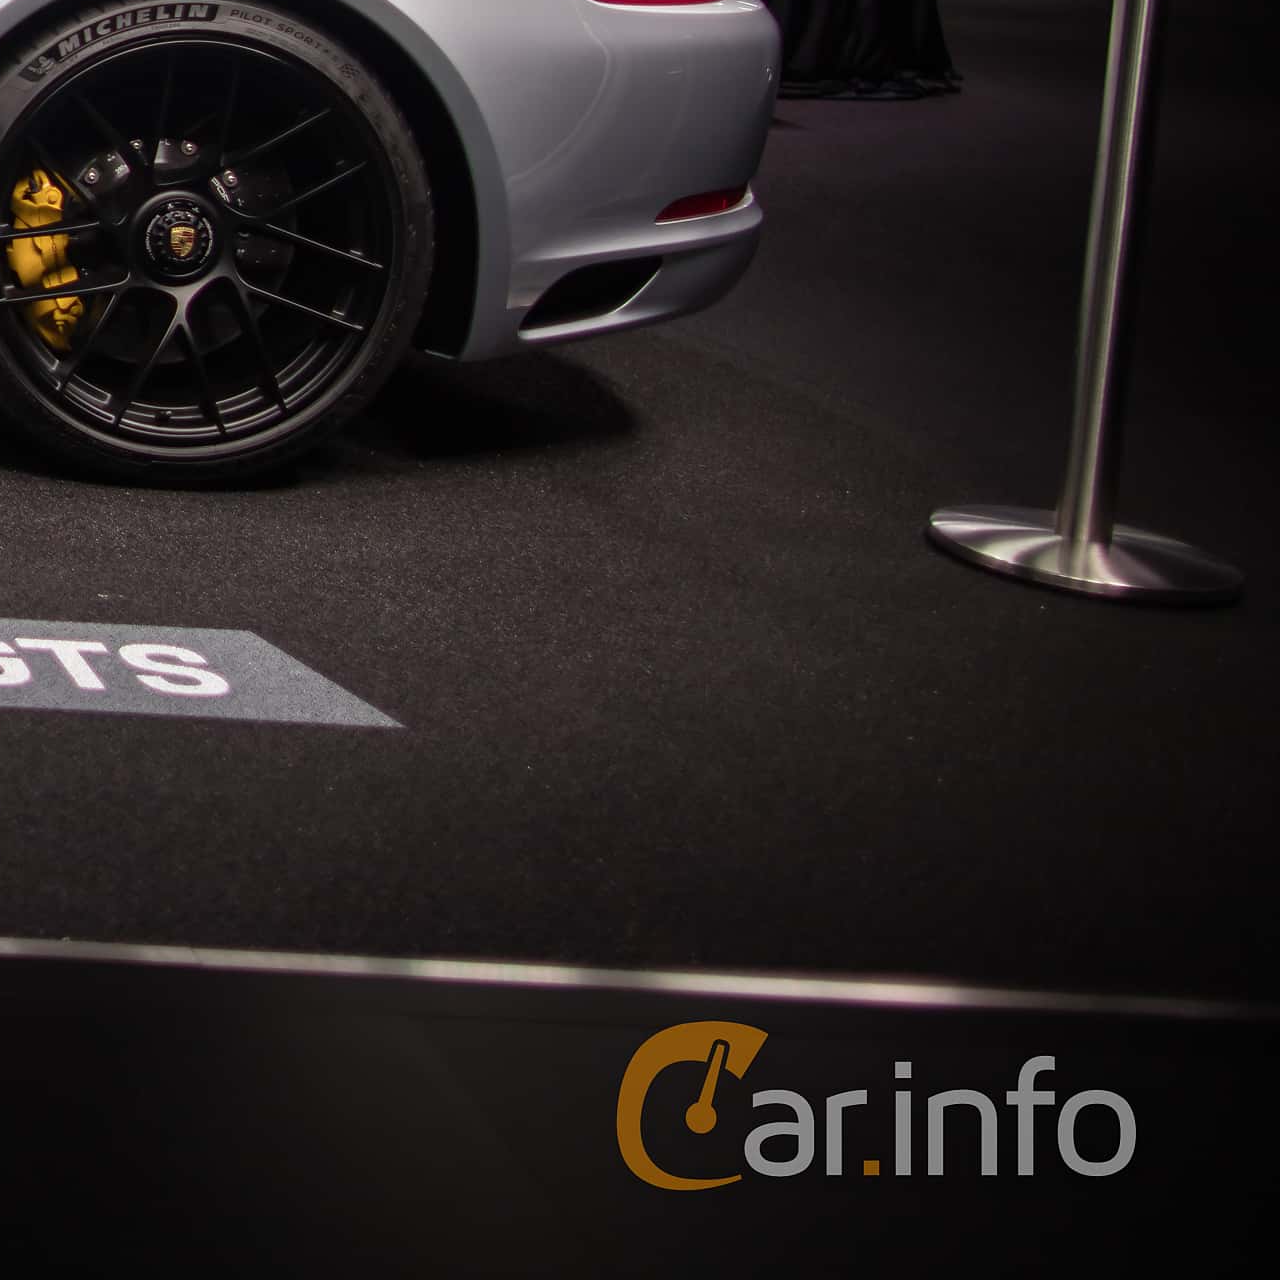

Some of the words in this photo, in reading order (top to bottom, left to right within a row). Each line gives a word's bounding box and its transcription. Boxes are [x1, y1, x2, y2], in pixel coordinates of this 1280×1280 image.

[57, 3, 209, 57] MICHELIN
[230, 9, 274, 25] PILOT
[277, 23, 321, 49] SPORT
